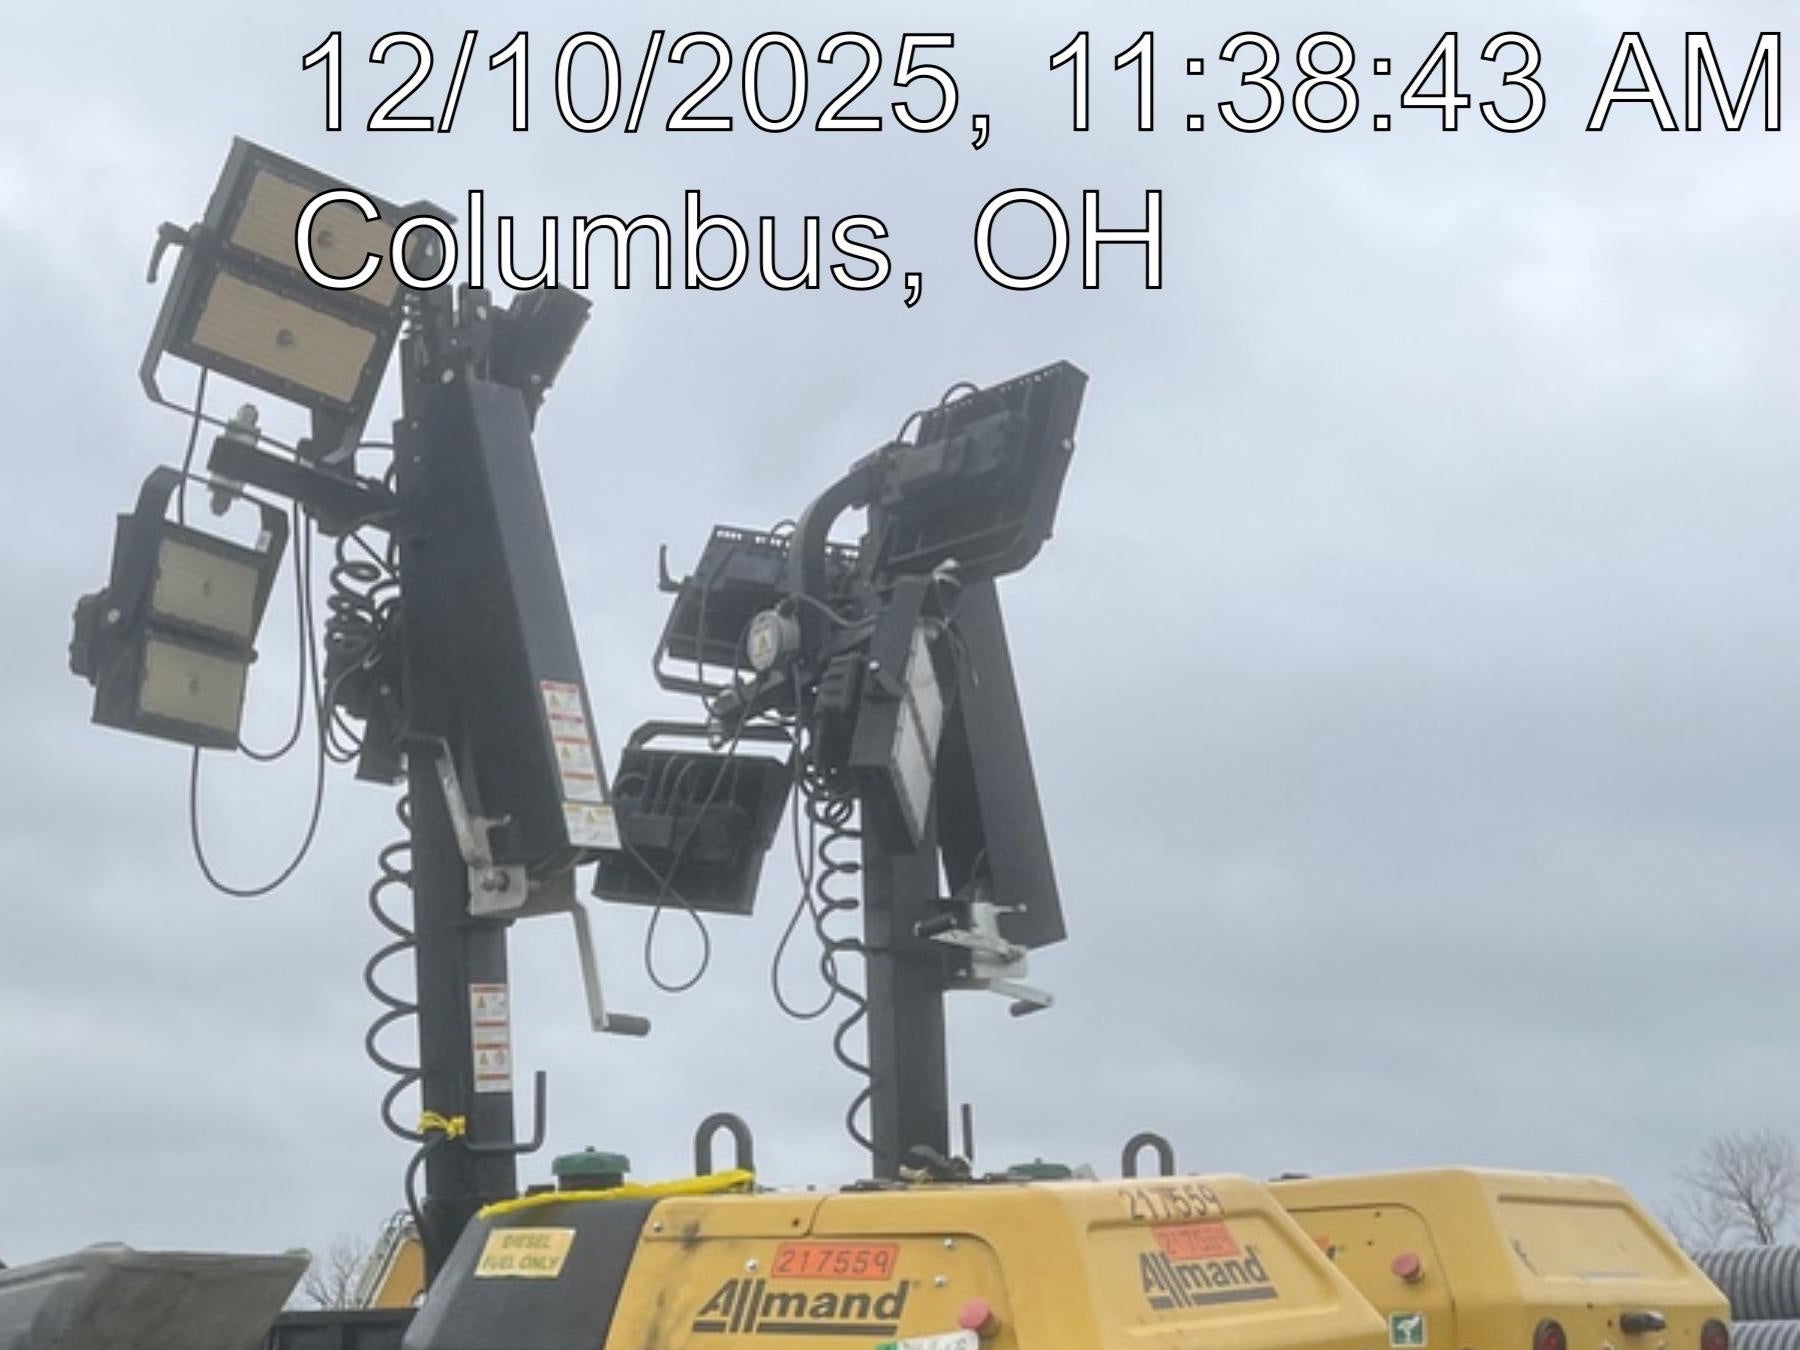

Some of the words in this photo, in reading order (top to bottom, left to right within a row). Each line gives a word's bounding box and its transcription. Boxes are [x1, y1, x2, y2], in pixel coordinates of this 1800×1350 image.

[1118, 1184, 1225, 1221] 217559
[502, 1235, 552, 1249] DIESEL
[483, 1256, 515, 1269] FUEL
[519, 1255, 561, 1269] ONLY
[778, 1250, 889, 1273] 217559
[1139, 1245, 1269, 1308] Allmand
[698, 1278, 910, 1332] Allmand
